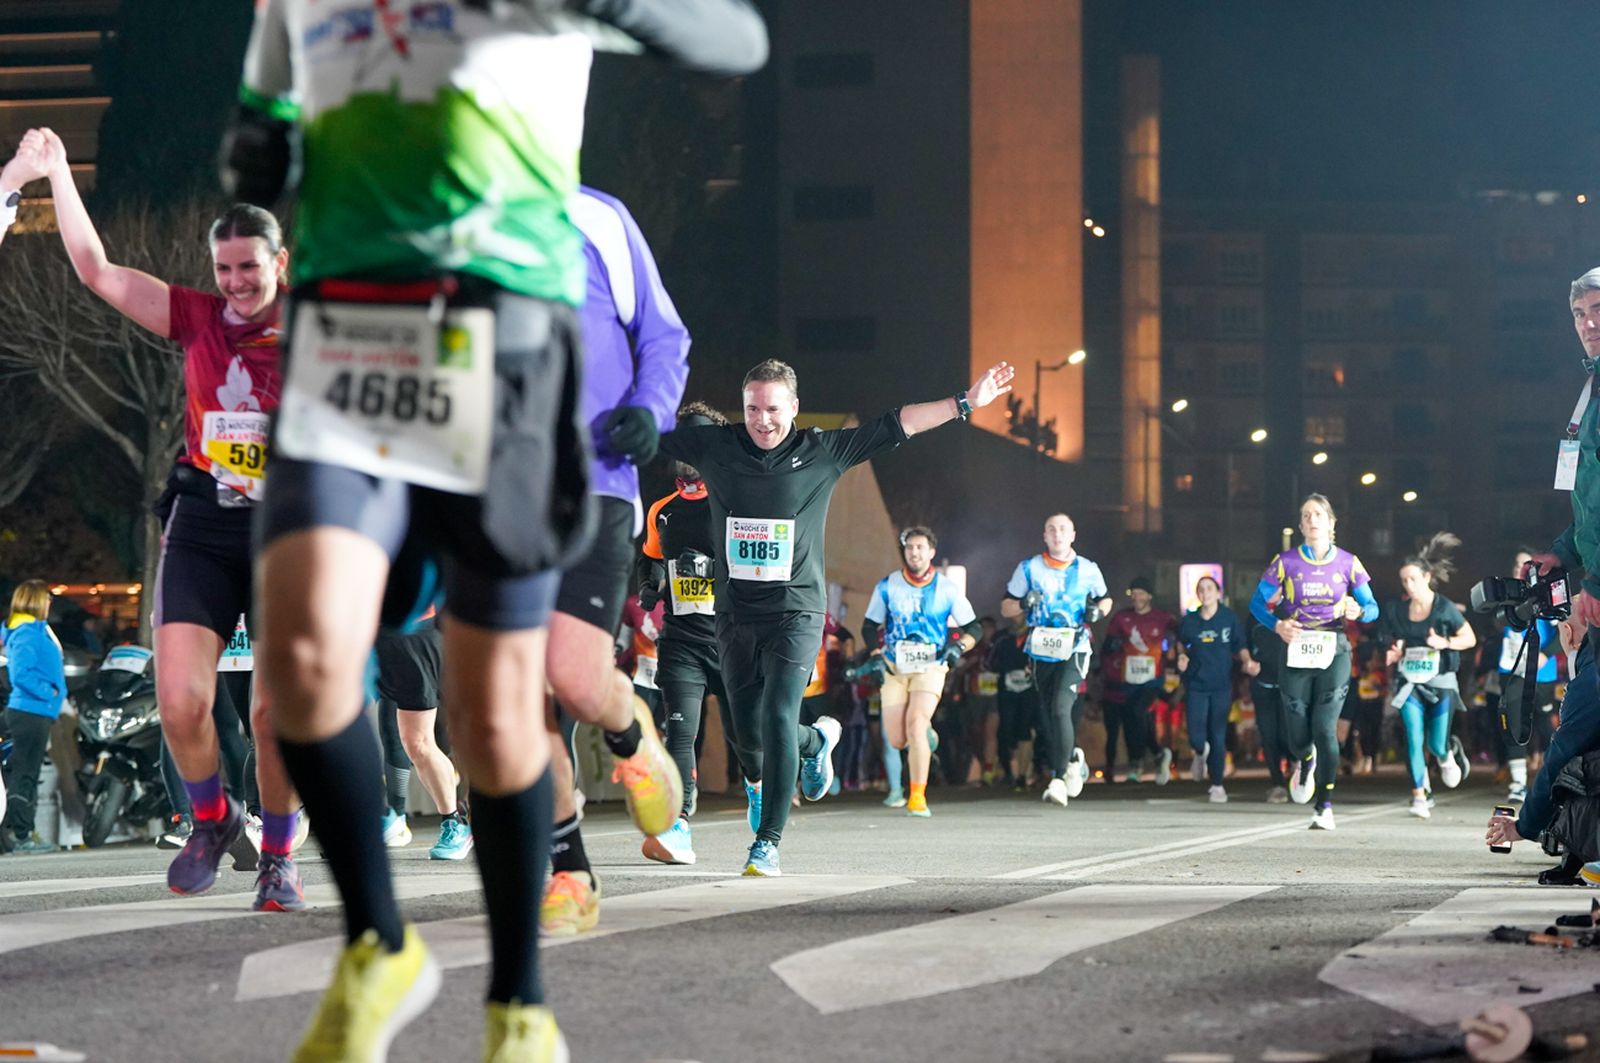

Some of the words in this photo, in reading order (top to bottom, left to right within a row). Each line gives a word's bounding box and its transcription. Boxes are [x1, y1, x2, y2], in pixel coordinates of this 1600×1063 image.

[325, 370, 451, 425] 4685
[229, 443, 267, 470] 59
[733, 531, 745, 539] SAN
[746, 532, 768, 540] ANTON
[738, 540, 780, 560] 8185
[678, 579, 716, 596] 13921
[223, 631, 250, 650] 641
[1042, 636, 1063, 649] 550
[1301, 643, 1324, 655] 959
